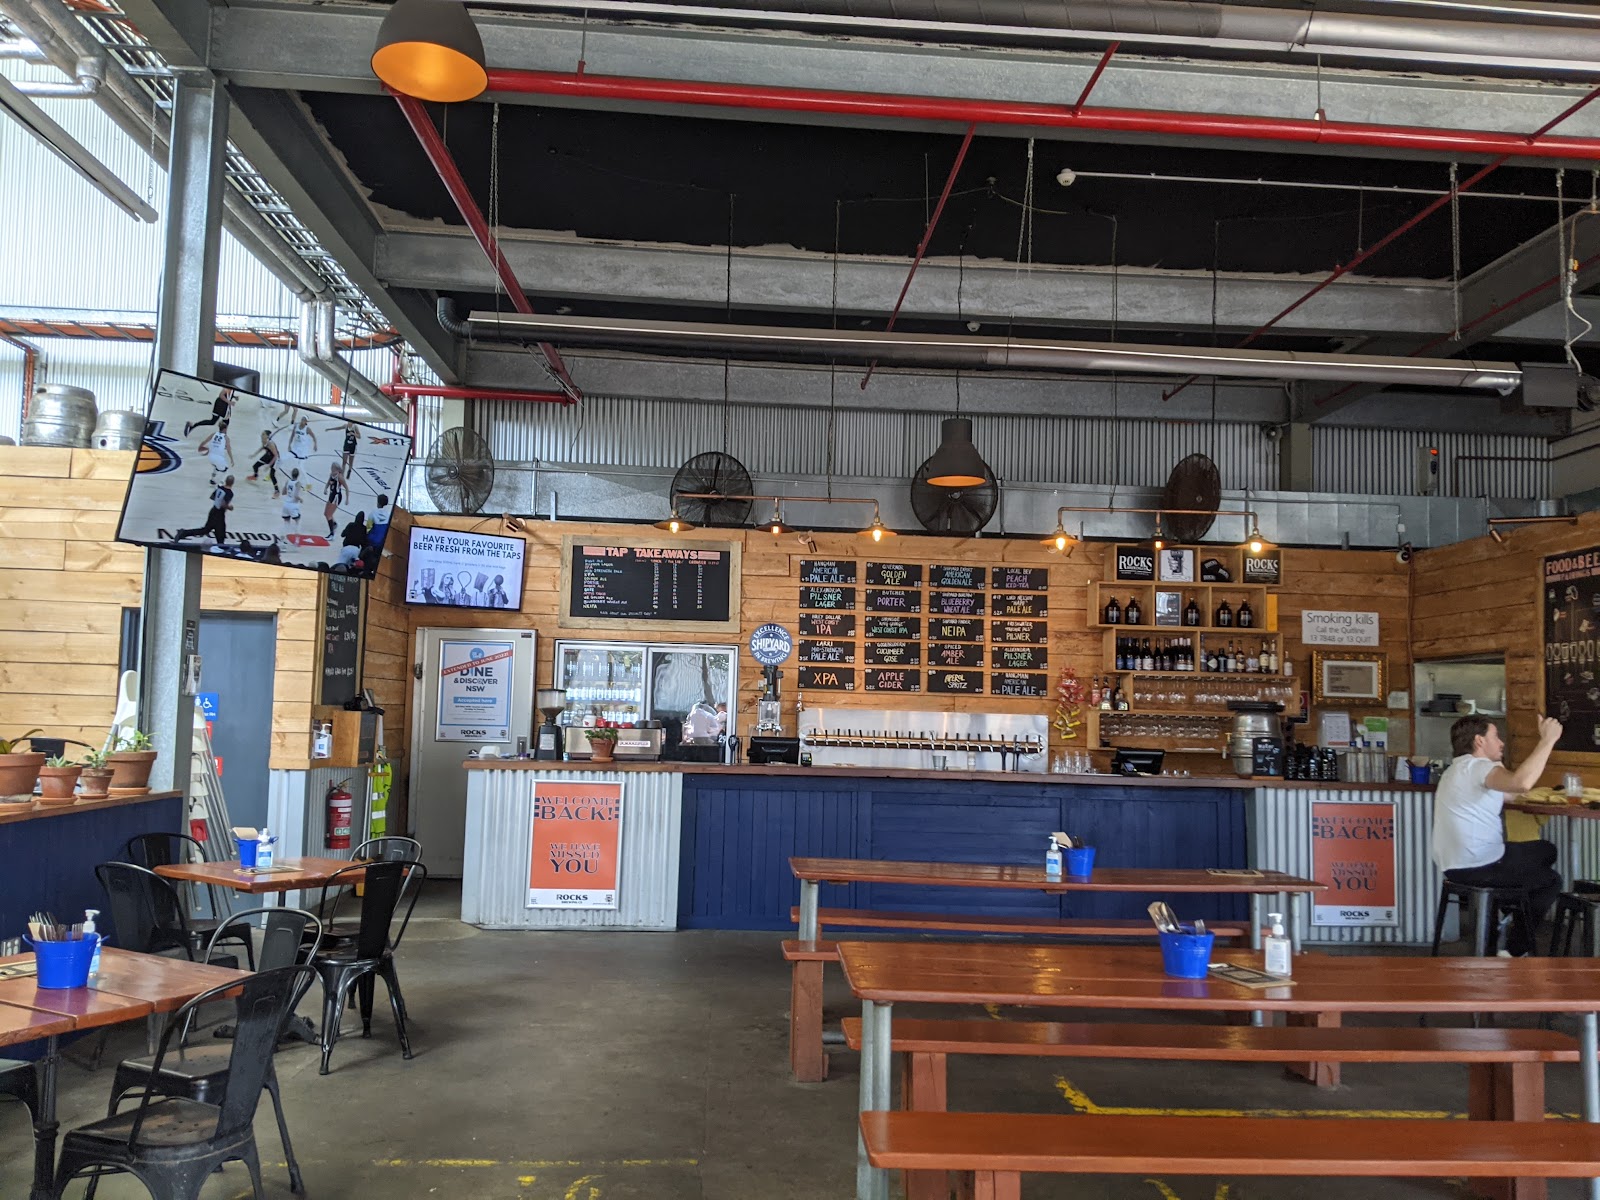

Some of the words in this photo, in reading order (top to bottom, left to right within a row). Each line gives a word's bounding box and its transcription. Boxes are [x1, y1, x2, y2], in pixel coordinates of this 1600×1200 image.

[423, 535, 445, 544] HAVE
[447, 537, 469, 546] YOUR
[472, 540, 514, 551] FAVOURITE
[414, 542, 432, 551] BEER
[435, 544, 460, 554] FRESH
[462, 547, 484, 556] FROM
[606, 547, 628, 556] TAP
[634, 548, 698, 559] TAKEAWAYS
[1119, 556, 1152, 571] ROCKS
[1246, 558, 1278, 573] ROCKS
[810, 574, 828, 583] PALE
[830, 575, 845, 583] ALE
[881, 570, 907, 579] GOLDEN
[810, 593, 842, 601] PILSNER
[877, 597, 906, 607] PORTER
[941, 598, 975, 606] BLUEBERRY
[1006, 606, 1020, 614] PALE
[1022, 606, 1032, 614] ALE
[1307, 612, 1352, 626] Smoking
[1356, 614, 1374, 624] kills
[754, 626, 789, 640] EXCELLENCE
[816, 625, 832, 635] IPA
[899, 627, 908, 635] IPA
[941, 626, 966, 637] NEIPA
[1006, 633, 1031, 642] PILSNER
[752, 638, 790, 653] SHIPYARD
[761, 653, 787, 664] BREWING
[827, 653, 840, 661] ALE
[941, 650, 965, 658] AMBER
[1004, 652, 1033, 661] PILSNER
[444, 663, 471, 674] EXTENDED
[460, 667, 493, 676] DINE
[813, 672, 838, 685] XPA
[878, 672, 904, 681] APPLE
[944, 674, 965, 683] APEROL
[878, 681, 902, 689] CIDER
[1001, 685, 1020, 695] PALE
[1022, 686, 1036, 695] ALE
[541, 796, 613, 805] WELCOME
[540, 806, 613, 820] BACK!
[1320, 817, 1384, 825] WELCOME
[1320, 826, 1388, 840] BACK!
[550, 850, 600, 858] MISSED
[550, 859, 598, 874] YOU
[1332, 868, 1377, 876] MISSED
[1332, 877, 1377, 891] YOU
